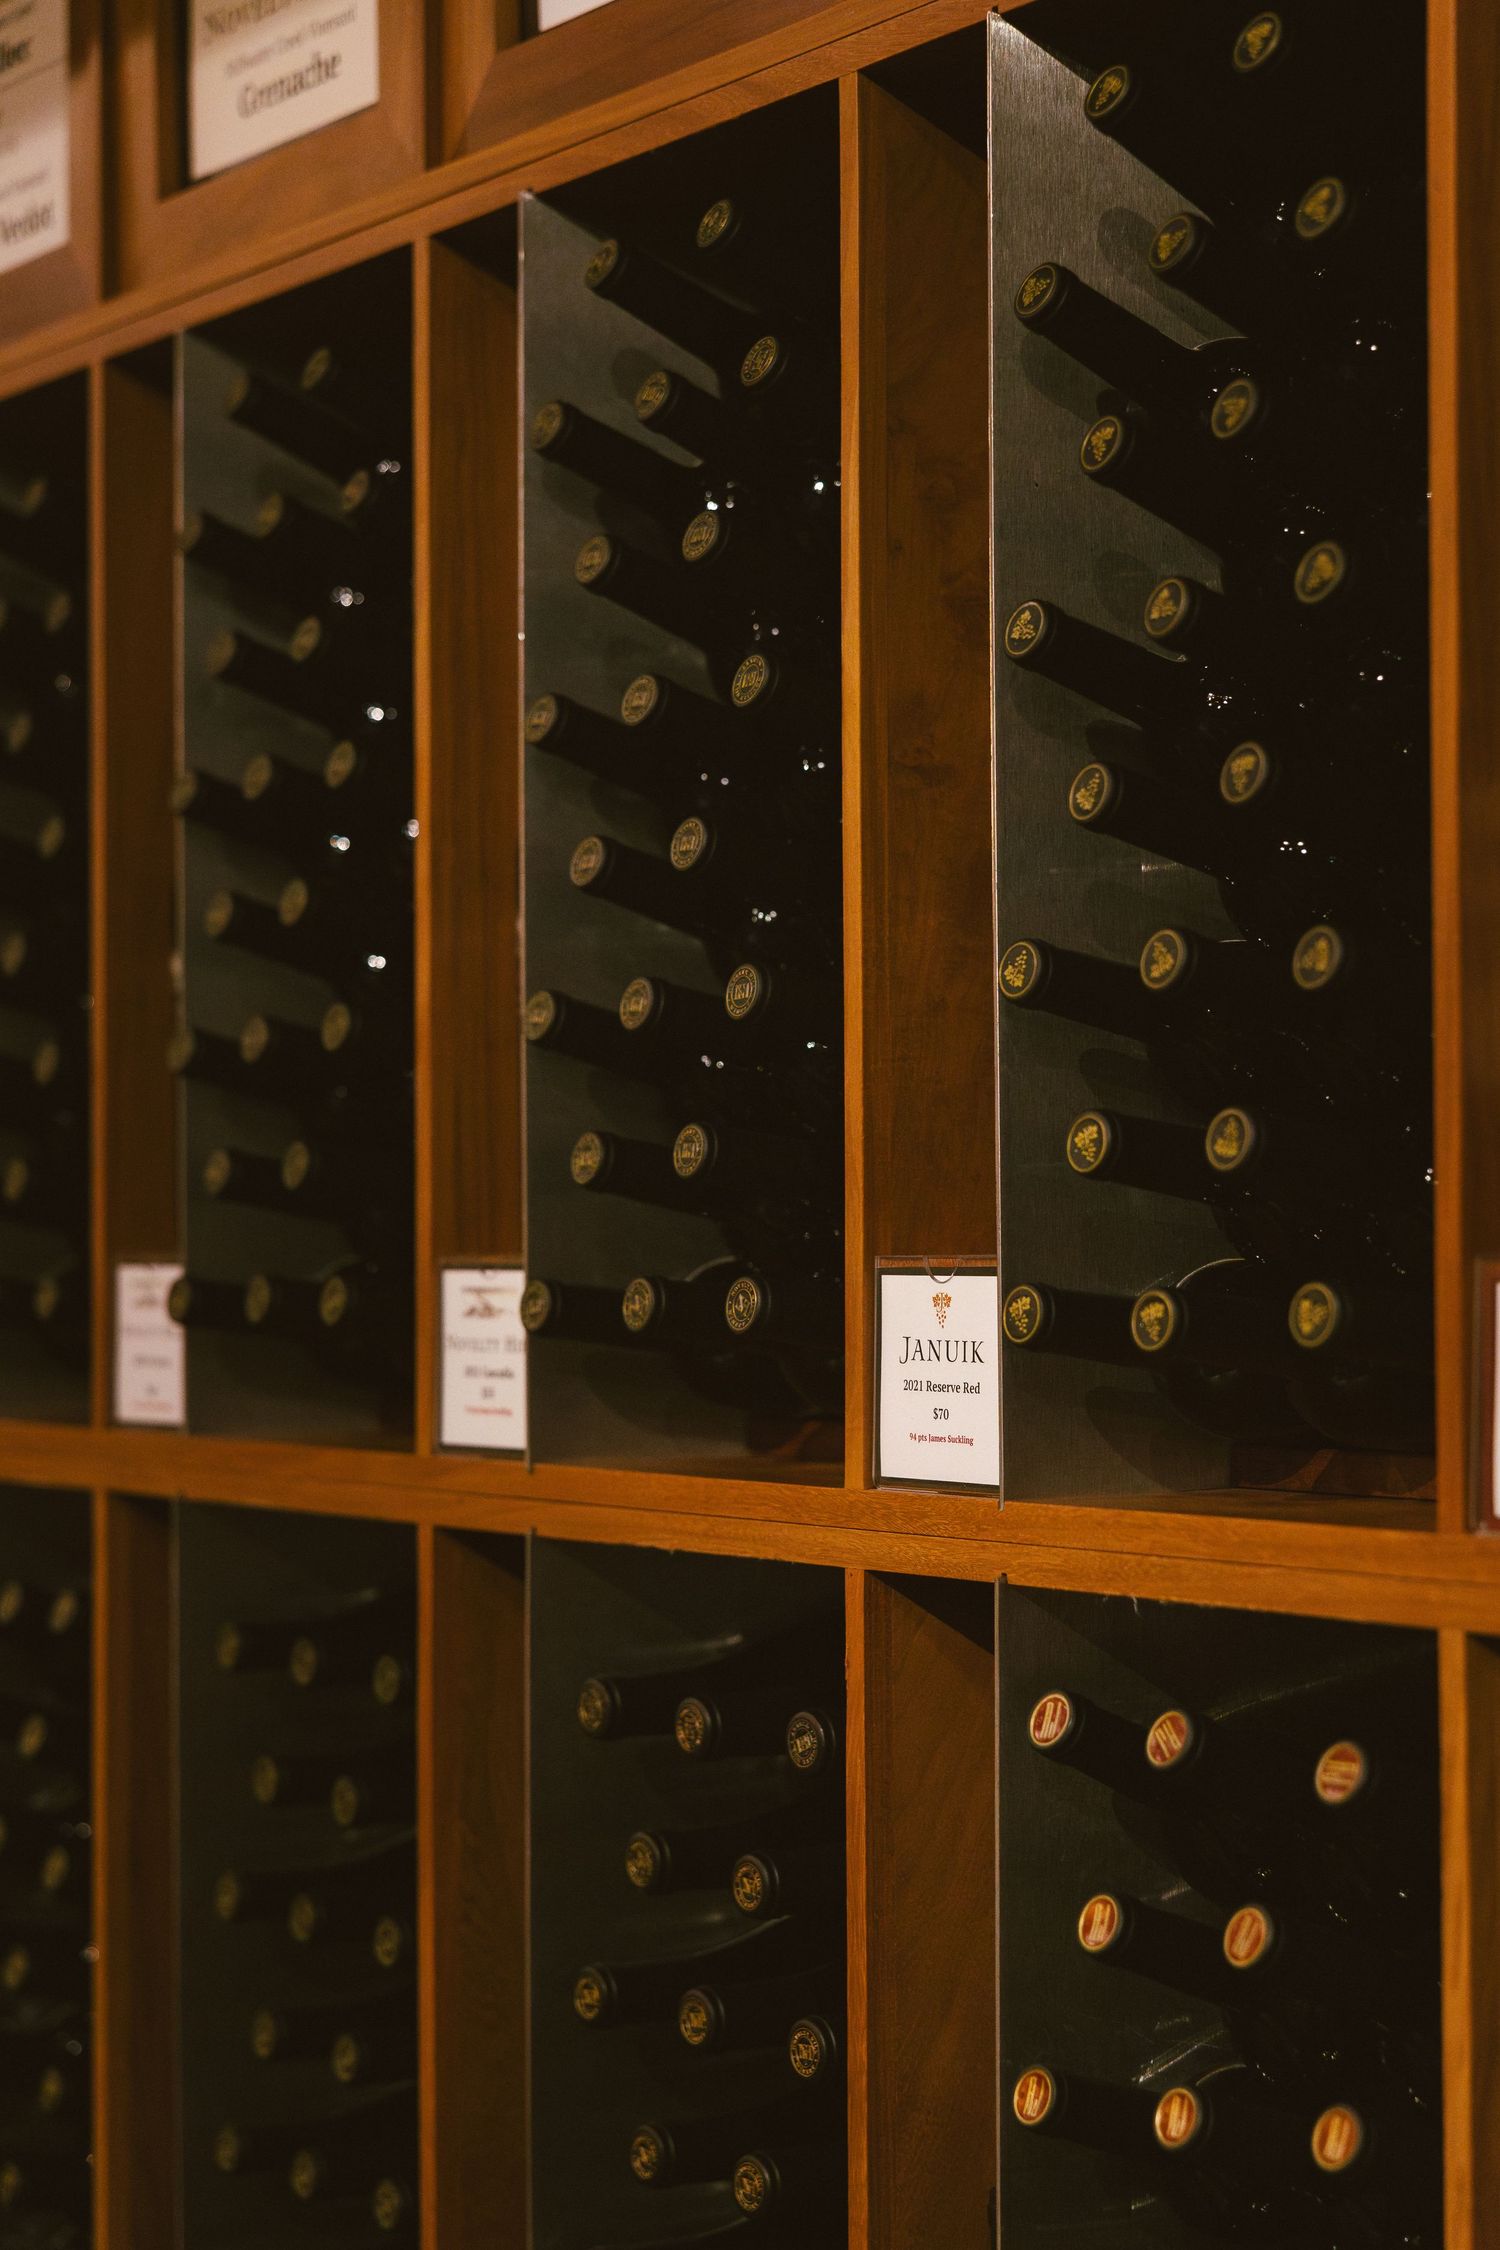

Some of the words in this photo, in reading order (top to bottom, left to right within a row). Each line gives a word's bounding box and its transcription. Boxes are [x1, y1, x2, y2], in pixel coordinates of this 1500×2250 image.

[899, 1336, 985, 1364] JANUIK
[903, 1379, 924, 1392] 2021
[926, 1380, 961, 1394] Reserve
[963, 1382, 981, 1395] Red
[933, 1407, 950, 1421] $70
[909, 1432, 917, 1441] 94
[918, 1433, 928, 1443] pts
[928, 1433, 947, 1444] James
[947, 1434, 974, 1446] Suckling
